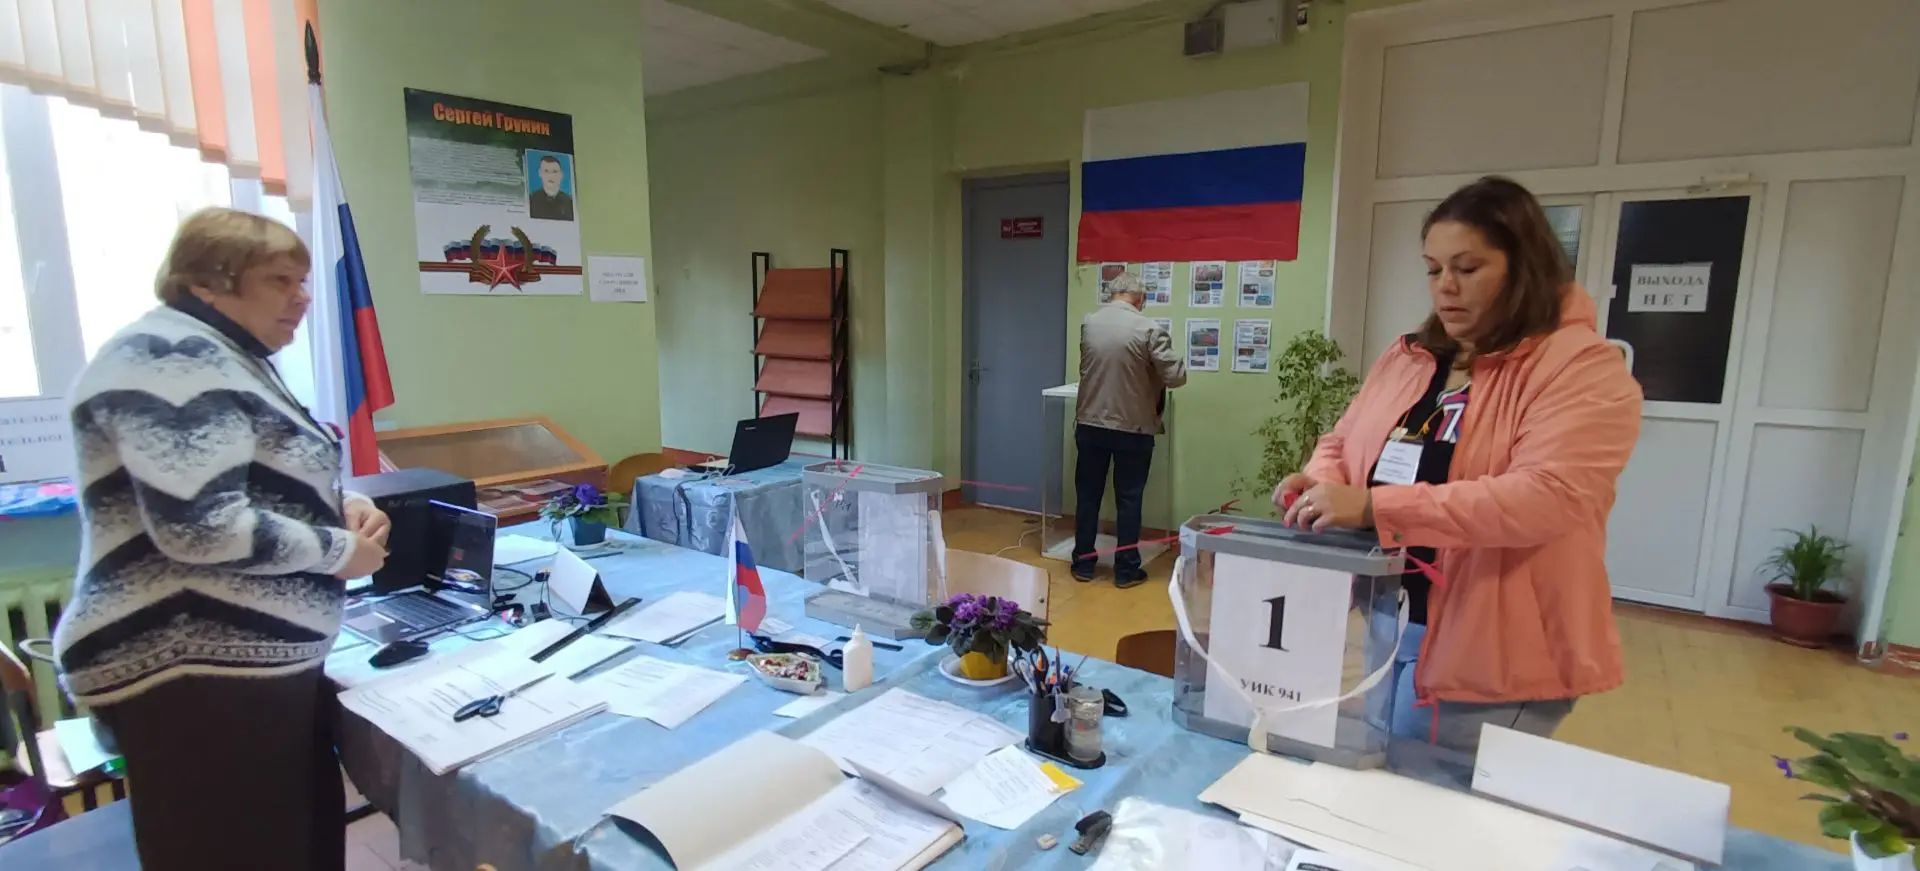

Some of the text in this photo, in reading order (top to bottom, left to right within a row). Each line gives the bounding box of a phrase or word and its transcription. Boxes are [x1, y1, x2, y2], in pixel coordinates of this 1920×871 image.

[432, 101, 493, 128] Сергей
[1637, 275, 1705, 287] ВЫХОДА
[1258, 595, 1290, 652] 1
[1240, 678, 1301, 702] УИК 941
